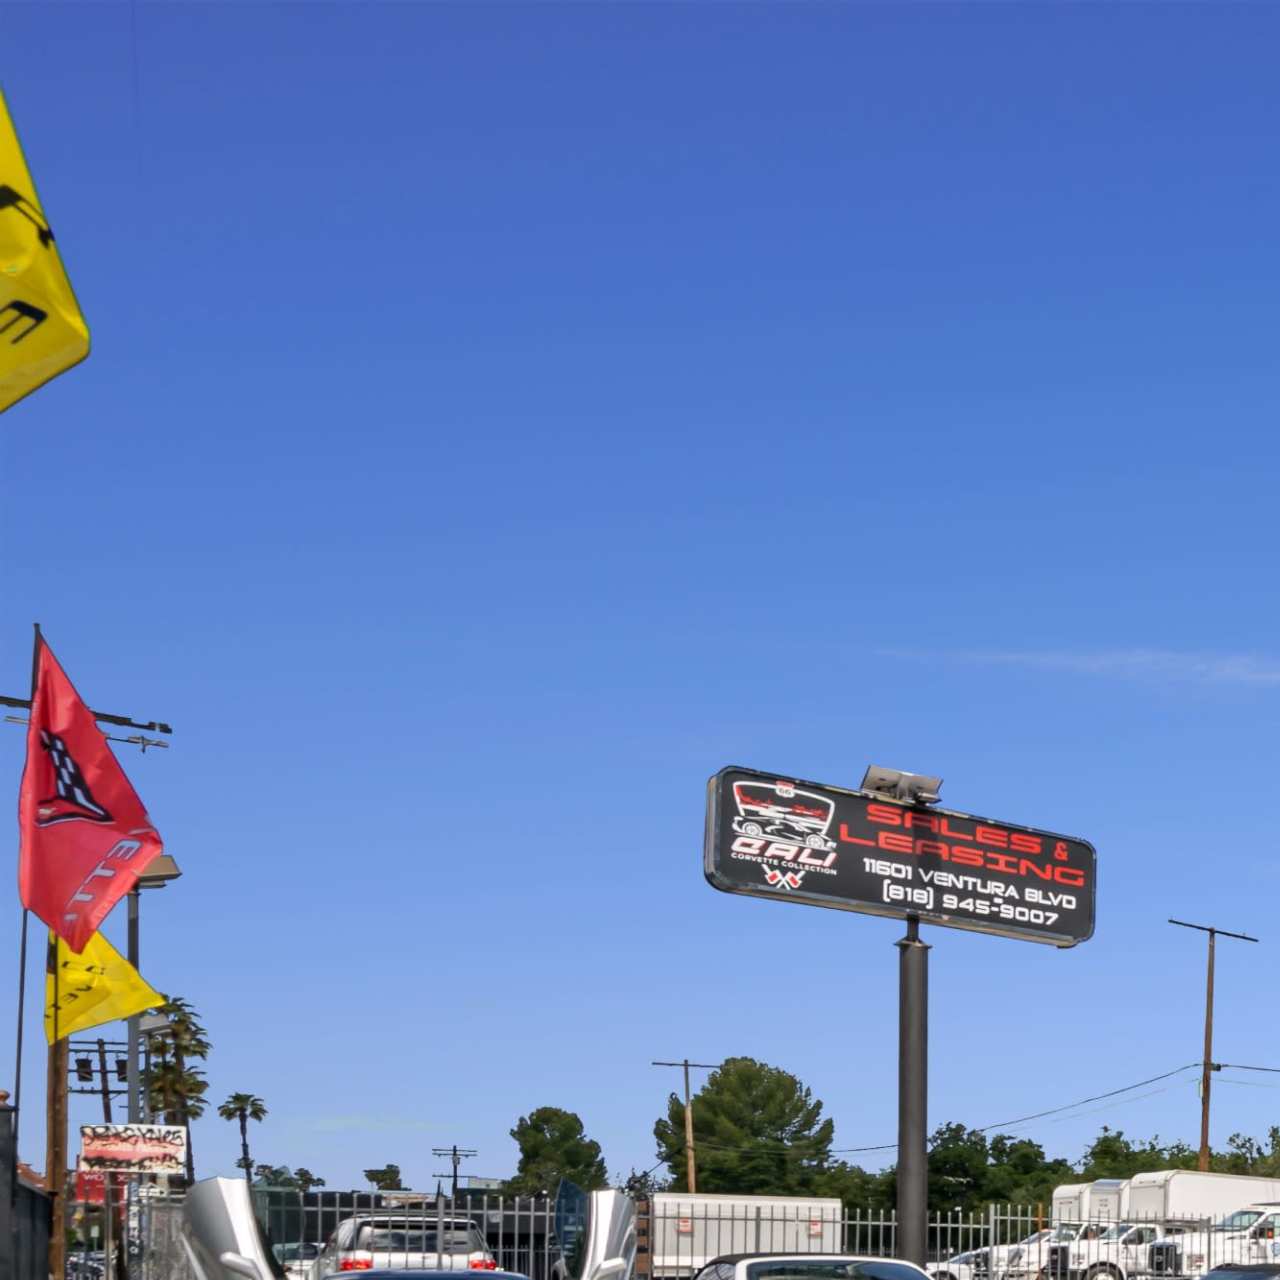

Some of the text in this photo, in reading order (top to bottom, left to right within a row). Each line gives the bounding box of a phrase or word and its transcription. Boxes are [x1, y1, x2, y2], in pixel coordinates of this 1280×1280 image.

[731, 837, 837, 868] CALI
[839, 822, 1085, 887] LEASING
[866, 803, 1069, 862] SALES &
[730, 852, 838, 876] CORVETTE COLLECTION
[863, 857, 1077, 910] 11601 VENTURA BLVD
[882, 878, 1059, 926] (818) 945-9007
